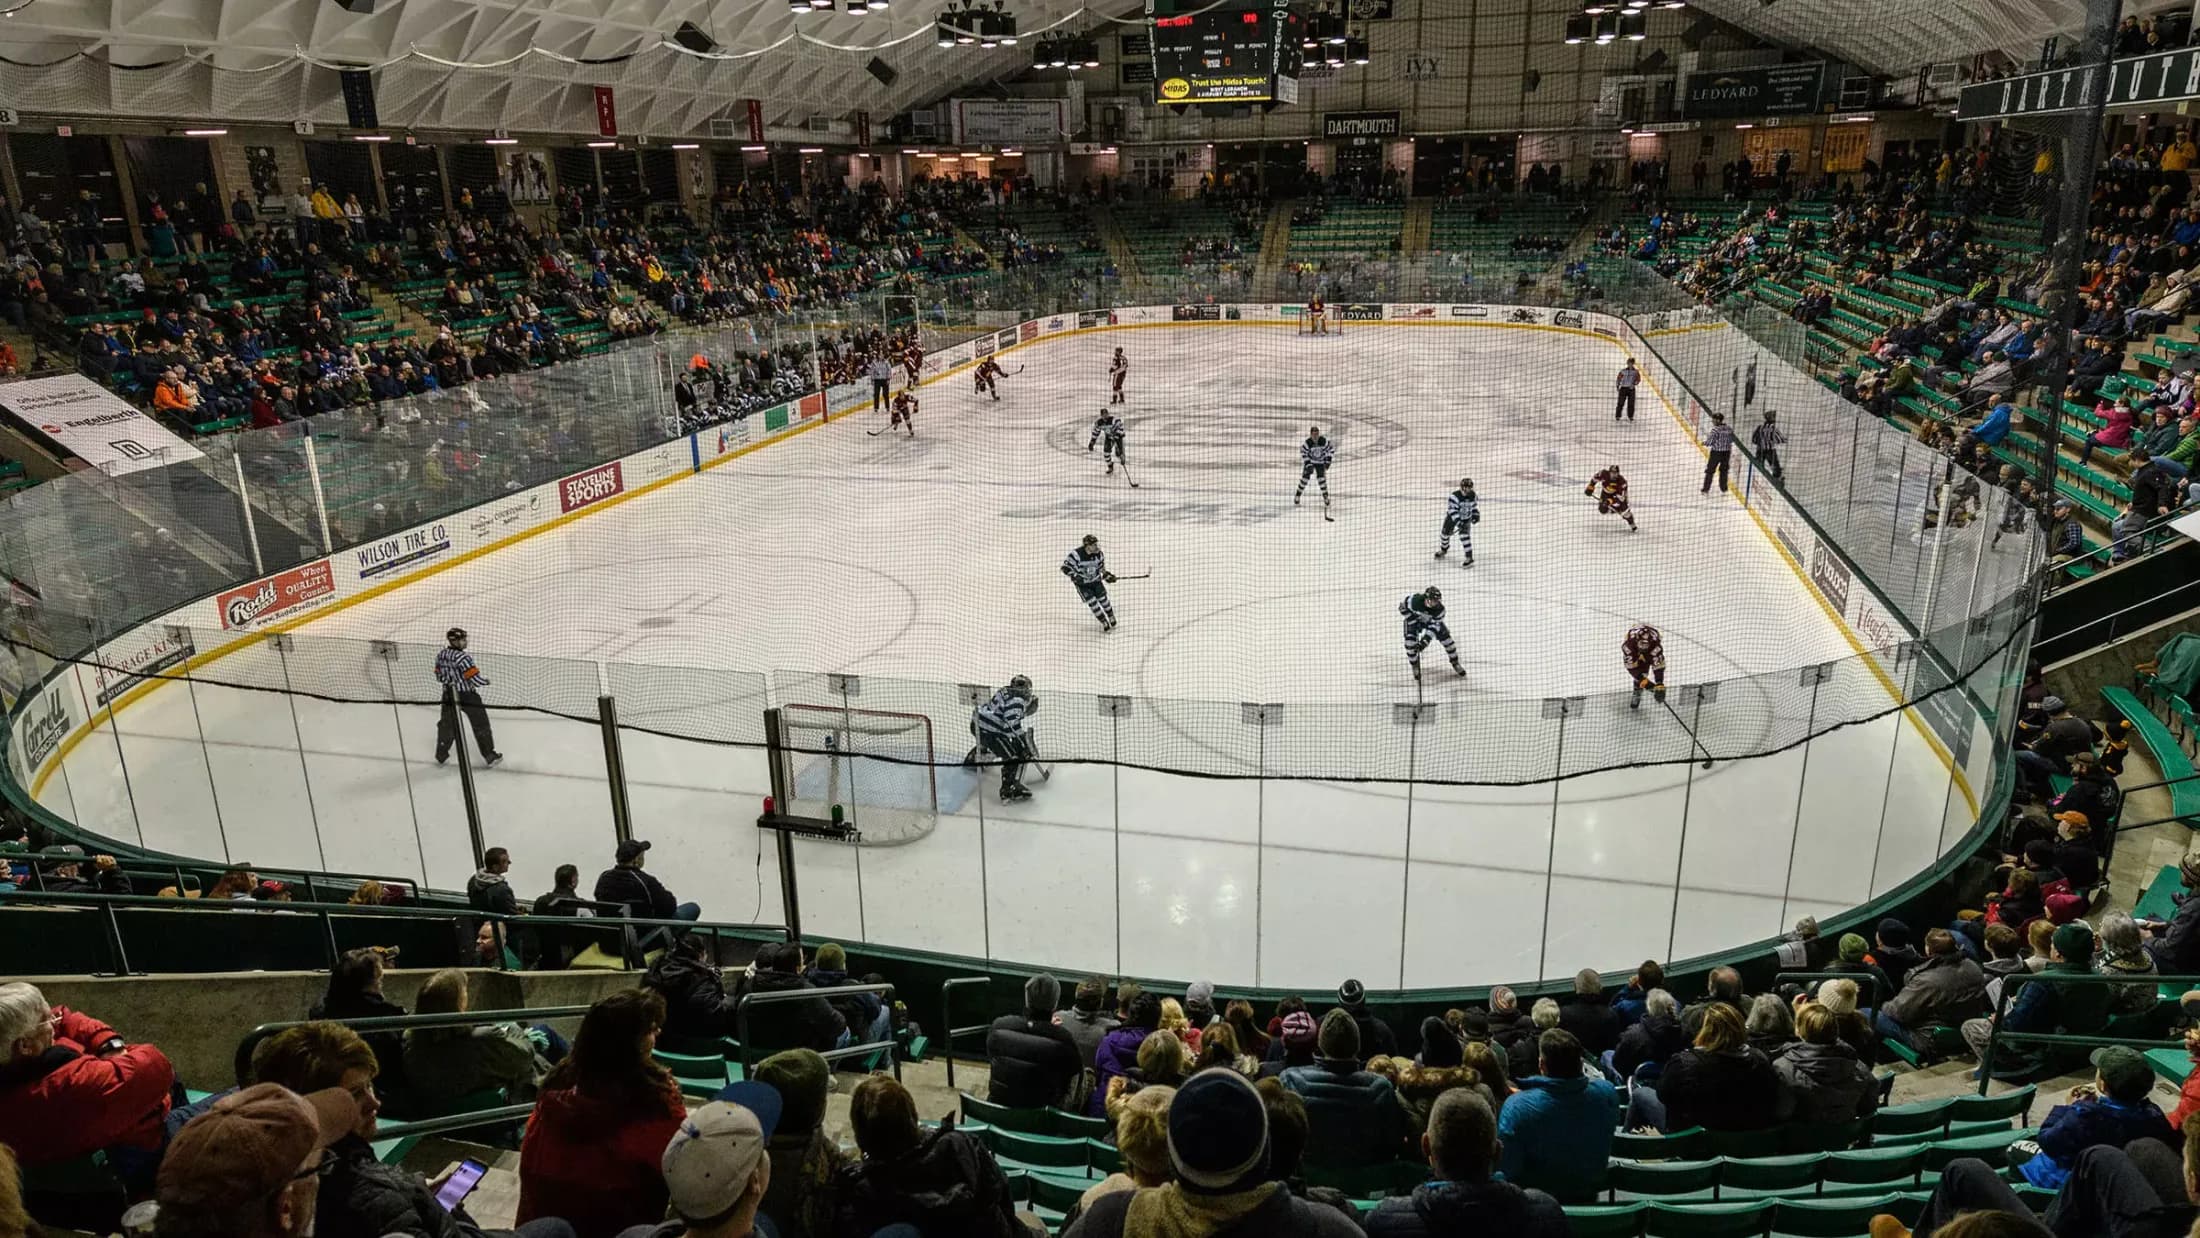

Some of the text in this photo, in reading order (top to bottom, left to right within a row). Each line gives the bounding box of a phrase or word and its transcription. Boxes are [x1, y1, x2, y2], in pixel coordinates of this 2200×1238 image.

[1406, 57, 1440, 73] IVY
[1164, 84, 1187, 93] MIDAS
[1223, 78, 1243, 86] Midas
[1244, 77, 1267, 85] Touch!
[1692, 85, 1759, 101] LEDYARD
[0, 111, 10, 122] 8
[301, 122, 307, 133] 7
[1327, 119, 1396, 135] DARTMOUTH
[1554, 310, 1583, 326] Carroll
[65, 409, 139, 428] Engelberth
[566, 467, 616, 494] STATELINE
[568, 481, 617, 508] SPORTS
[357, 539, 400, 568] WILSON
[404, 530, 426, 552] TIRE
[432, 524, 449, 542] CO.
[301, 565, 327, 578] When
[286, 573, 328, 595] QUALITY
[300, 585, 330, 600] Counts
[230, 581, 277, 625] Rodd
[22, 687, 65, 759] Carroll
